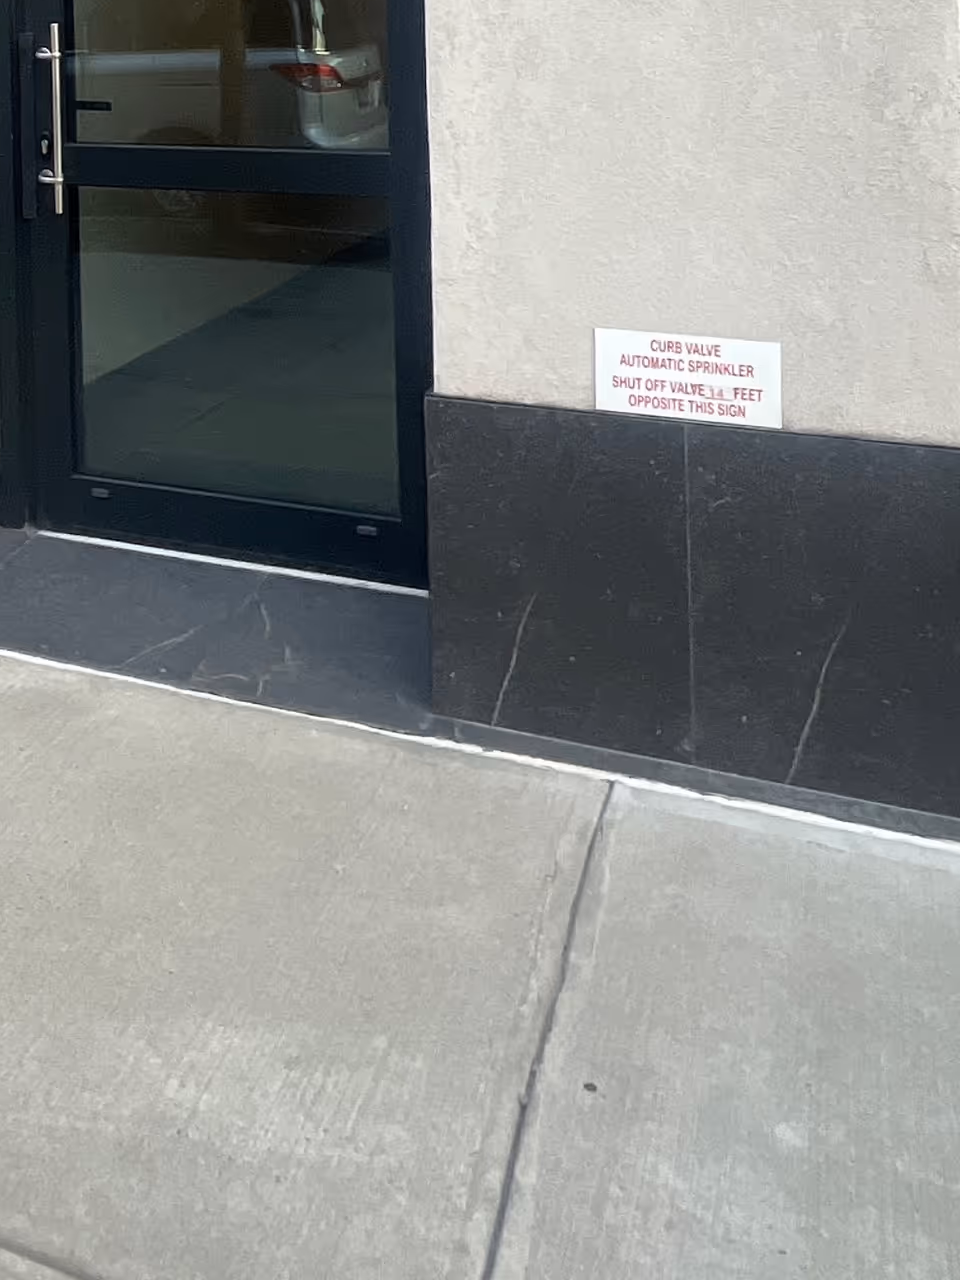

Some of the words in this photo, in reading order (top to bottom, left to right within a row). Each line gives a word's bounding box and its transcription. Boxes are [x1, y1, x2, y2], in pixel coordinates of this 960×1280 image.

[650, 339, 682, 353] CURB
[685, 343, 721, 357] VALVE
[620, 353, 685, 371] AUTOMATIC
[688, 360, 755, 378] SPRINKLER
[612, 375, 642, 389] SHUT
[645, 378, 667, 392] OFF
[670, 380, 705, 396] VALVE
[733, 387, 763, 402] FEET
[628, 394, 685, 412] OPPOSITE
[688, 400, 715, 415] THIS
[717, 403, 746, 418] SIGN
